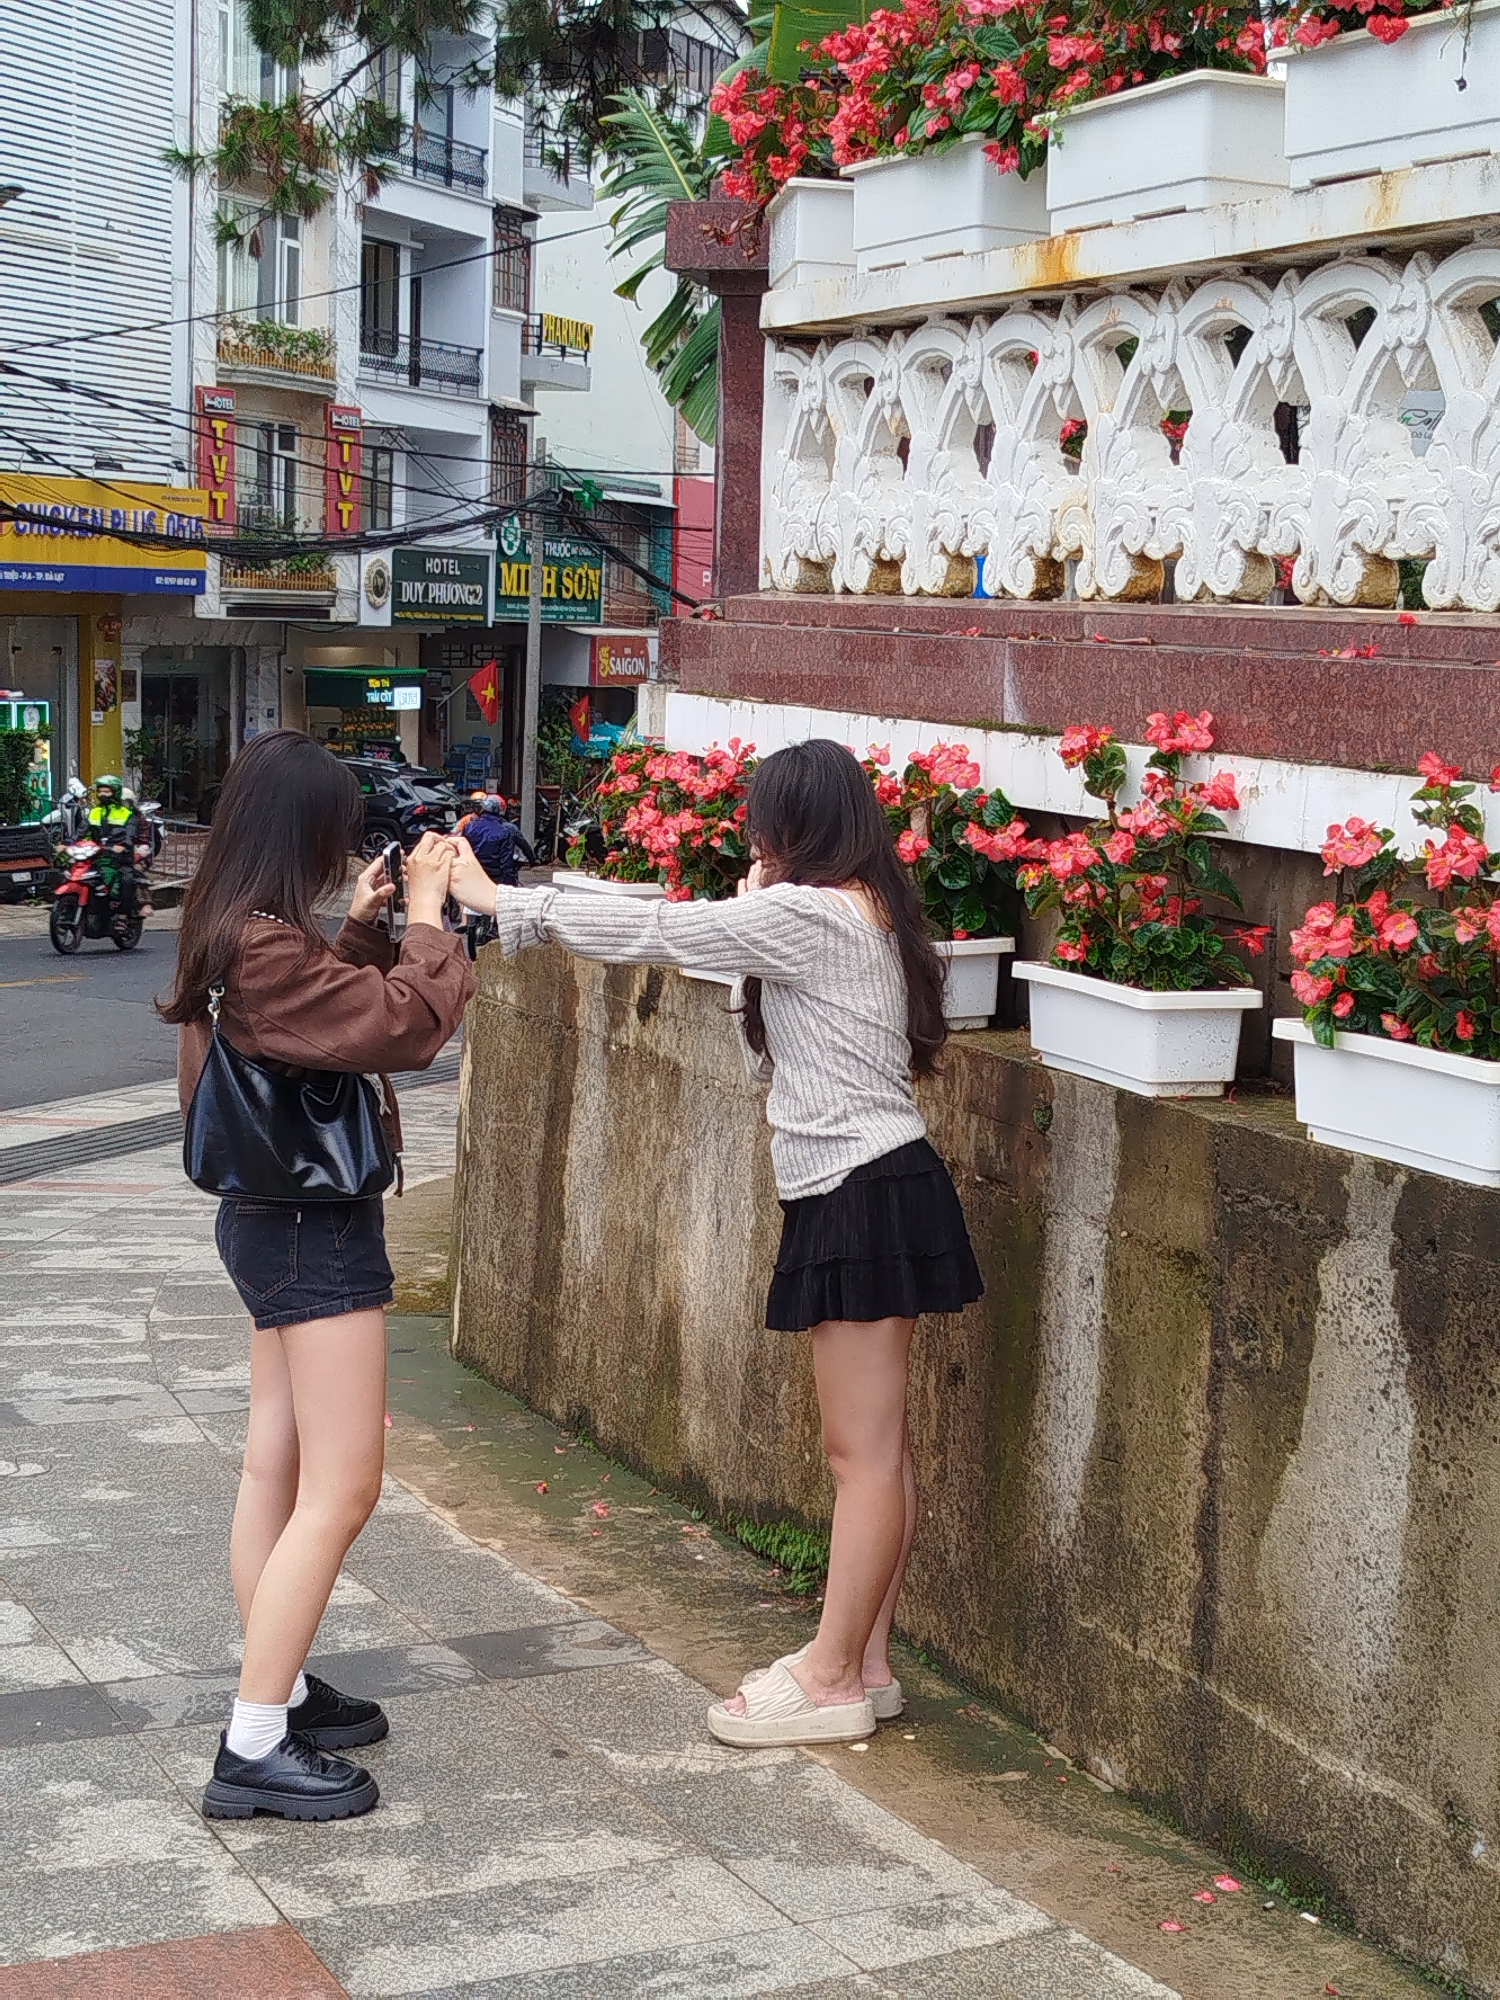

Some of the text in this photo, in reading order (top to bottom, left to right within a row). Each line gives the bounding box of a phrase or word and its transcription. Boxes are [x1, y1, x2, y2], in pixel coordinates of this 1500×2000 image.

[542, 311, 595, 353] PHARMACY
[205, 394, 233, 410] HOTEL
[332, 411, 360, 427] HOTEL
[14, 502, 105, 537] CHICKEN
[425, 556, 461, 576] HOTEL
[401, 580, 427, 604] DUY
[561, 562, 601, 600] SƠN
[610, 656, 646, 676] SAIGON
